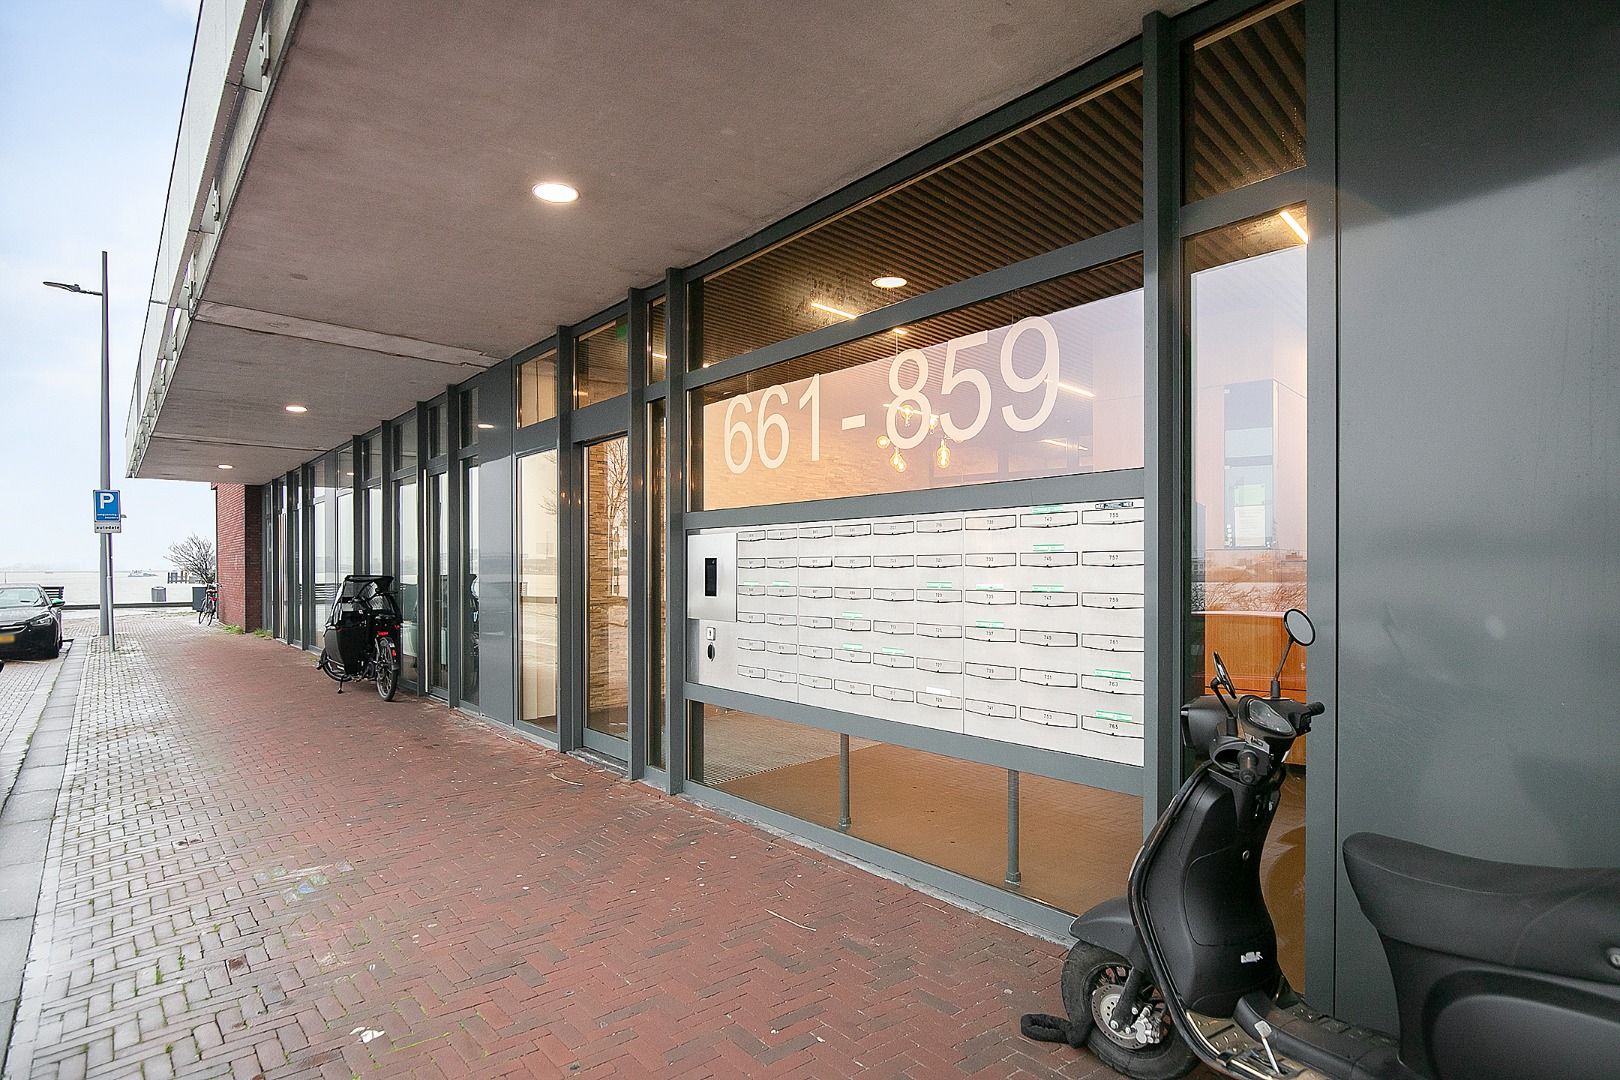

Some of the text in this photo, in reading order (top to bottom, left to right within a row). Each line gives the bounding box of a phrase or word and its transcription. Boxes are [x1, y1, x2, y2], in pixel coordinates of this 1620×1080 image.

[723, 373, 821, 474] 661
[886, 316, 1060, 449] 859
[99, 493, 114, 509] P
